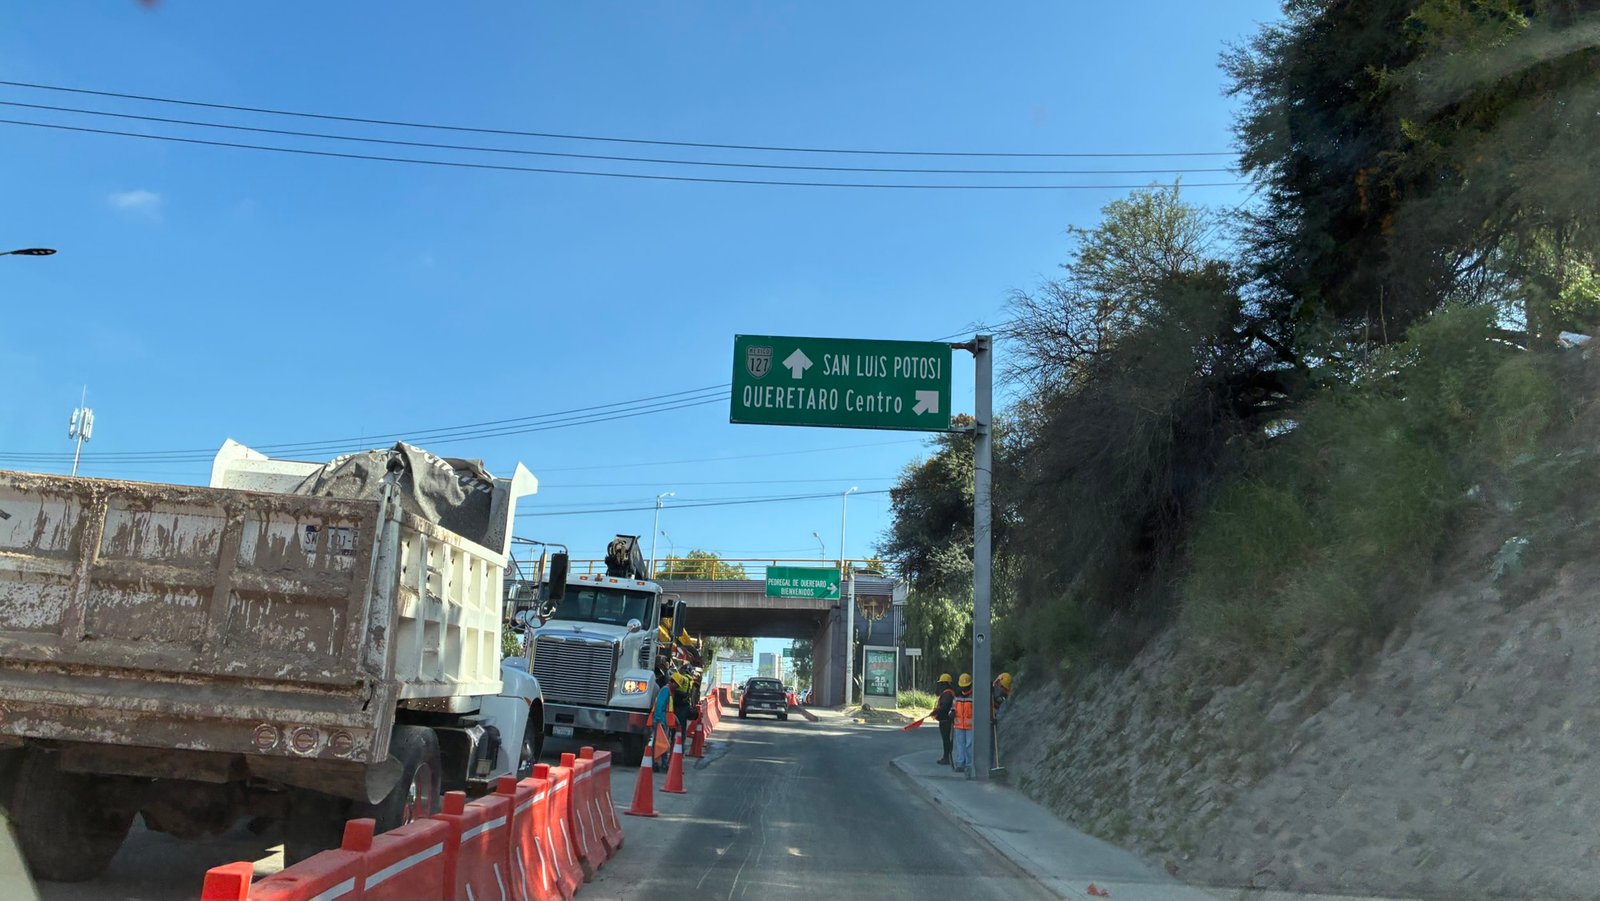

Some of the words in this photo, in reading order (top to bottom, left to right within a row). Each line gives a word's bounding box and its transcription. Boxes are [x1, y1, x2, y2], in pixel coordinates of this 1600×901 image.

[751, 357, 769, 372] 127
[823, 353, 851, 376] SAN
[856, 355, 887, 378] LUIS
[893, 356, 941, 380] POTOSI
[742, 385, 838, 410] QUERETARO
[845, 389, 903, 414] Centro
[767, 578, 791, 587] PEDREGAL
[792, 579, 799, 587] DE
[800, 579, 827, 588] QUERETARO
[780, 587, 814, 596] BIENVENIDOS
